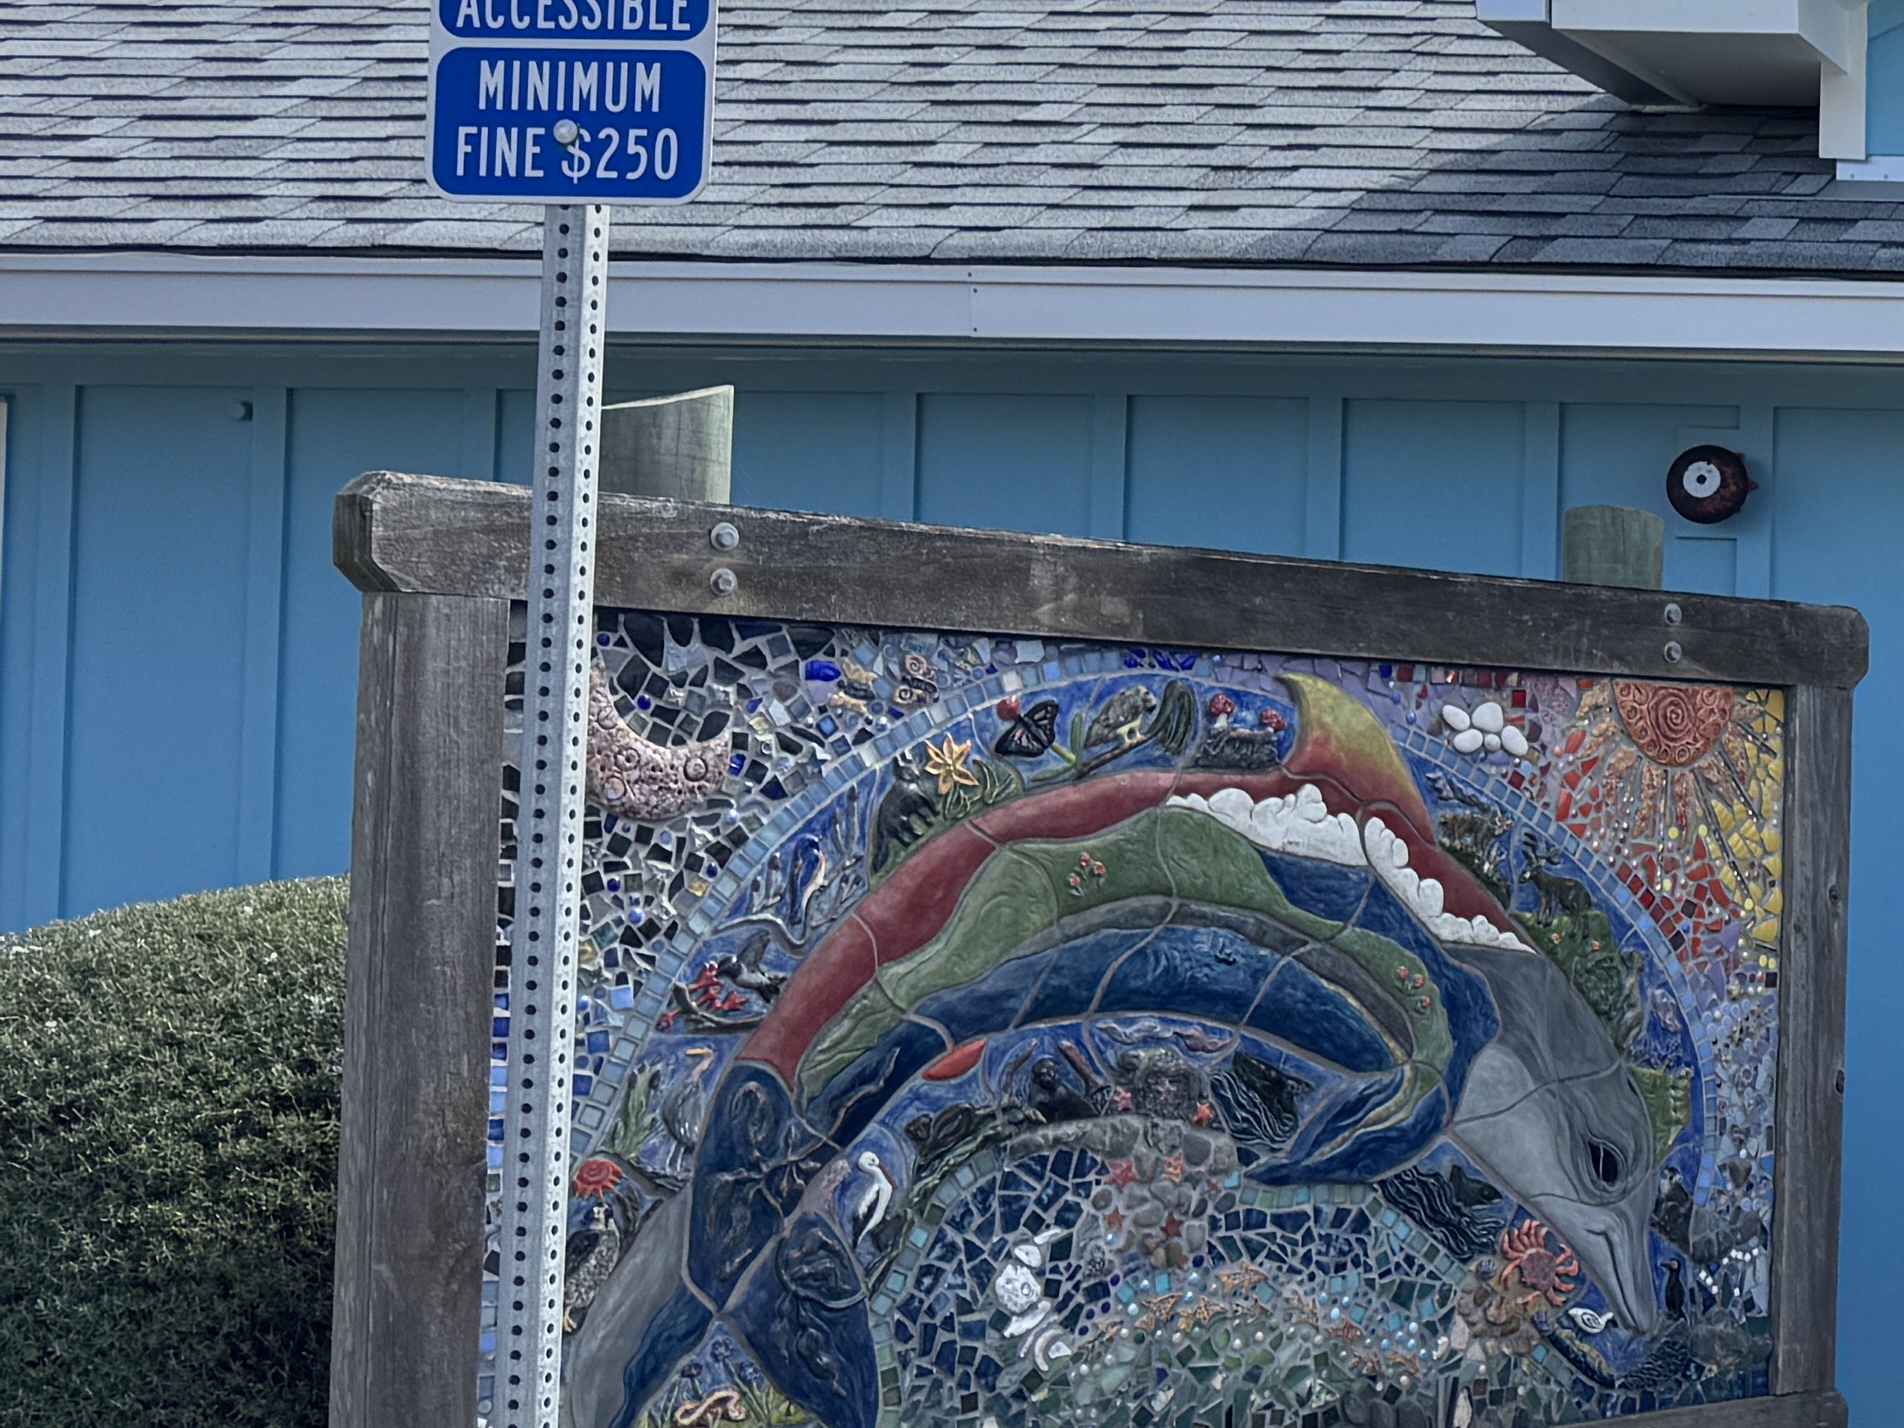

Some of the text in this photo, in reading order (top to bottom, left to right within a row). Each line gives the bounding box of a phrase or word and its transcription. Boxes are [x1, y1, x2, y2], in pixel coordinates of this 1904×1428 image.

[478, 60, 661, 113] MINIMUM
[456, 126, 678, 185] FINE $250
